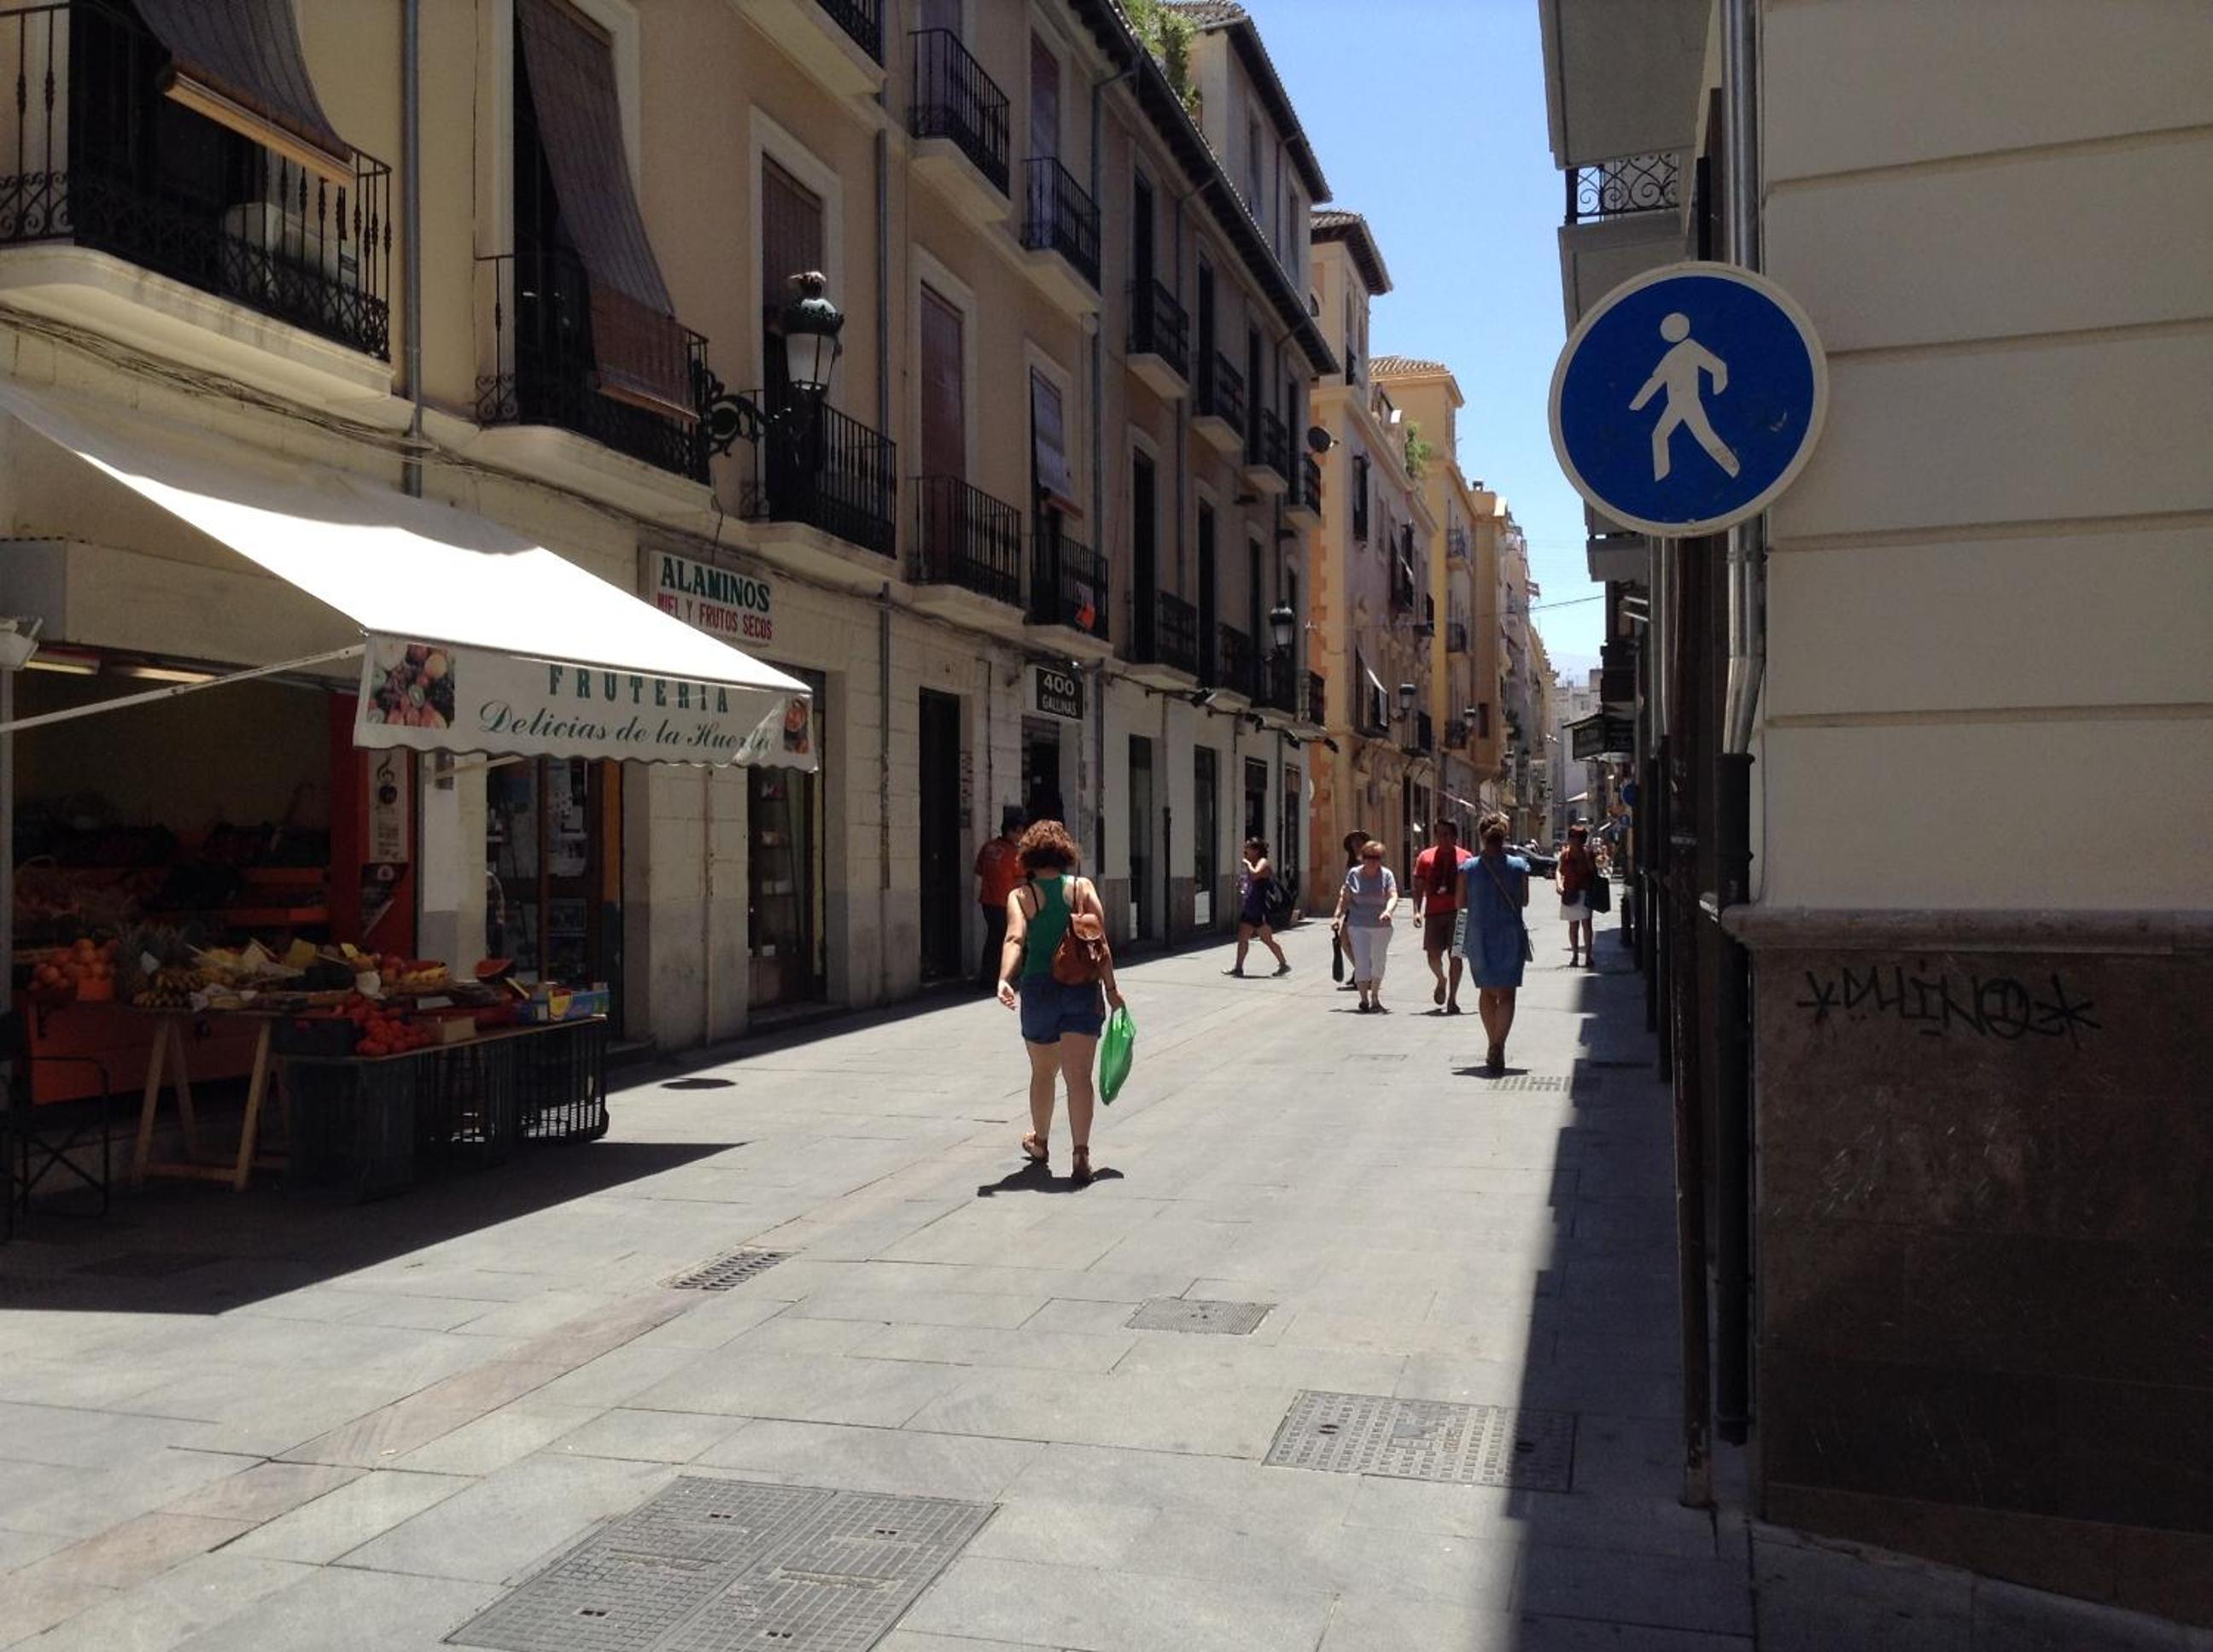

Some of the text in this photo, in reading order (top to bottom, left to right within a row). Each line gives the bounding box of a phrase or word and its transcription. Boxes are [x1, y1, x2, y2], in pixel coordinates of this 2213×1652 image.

[660, 557, 770, 612] ALAMINOS
[686, 600, 693, 622] Y
[699, 603, 738, 632] FRUTOS
[743, 613, 773, 639] SECOS
[549, 664, 728, 712] FRUTERIA
[1043, 674, 1075, 697] 400
[479, 698, 606, 743] Delicias
[616, 716, 650, 744] de
[656, 719, 680, 745] la
